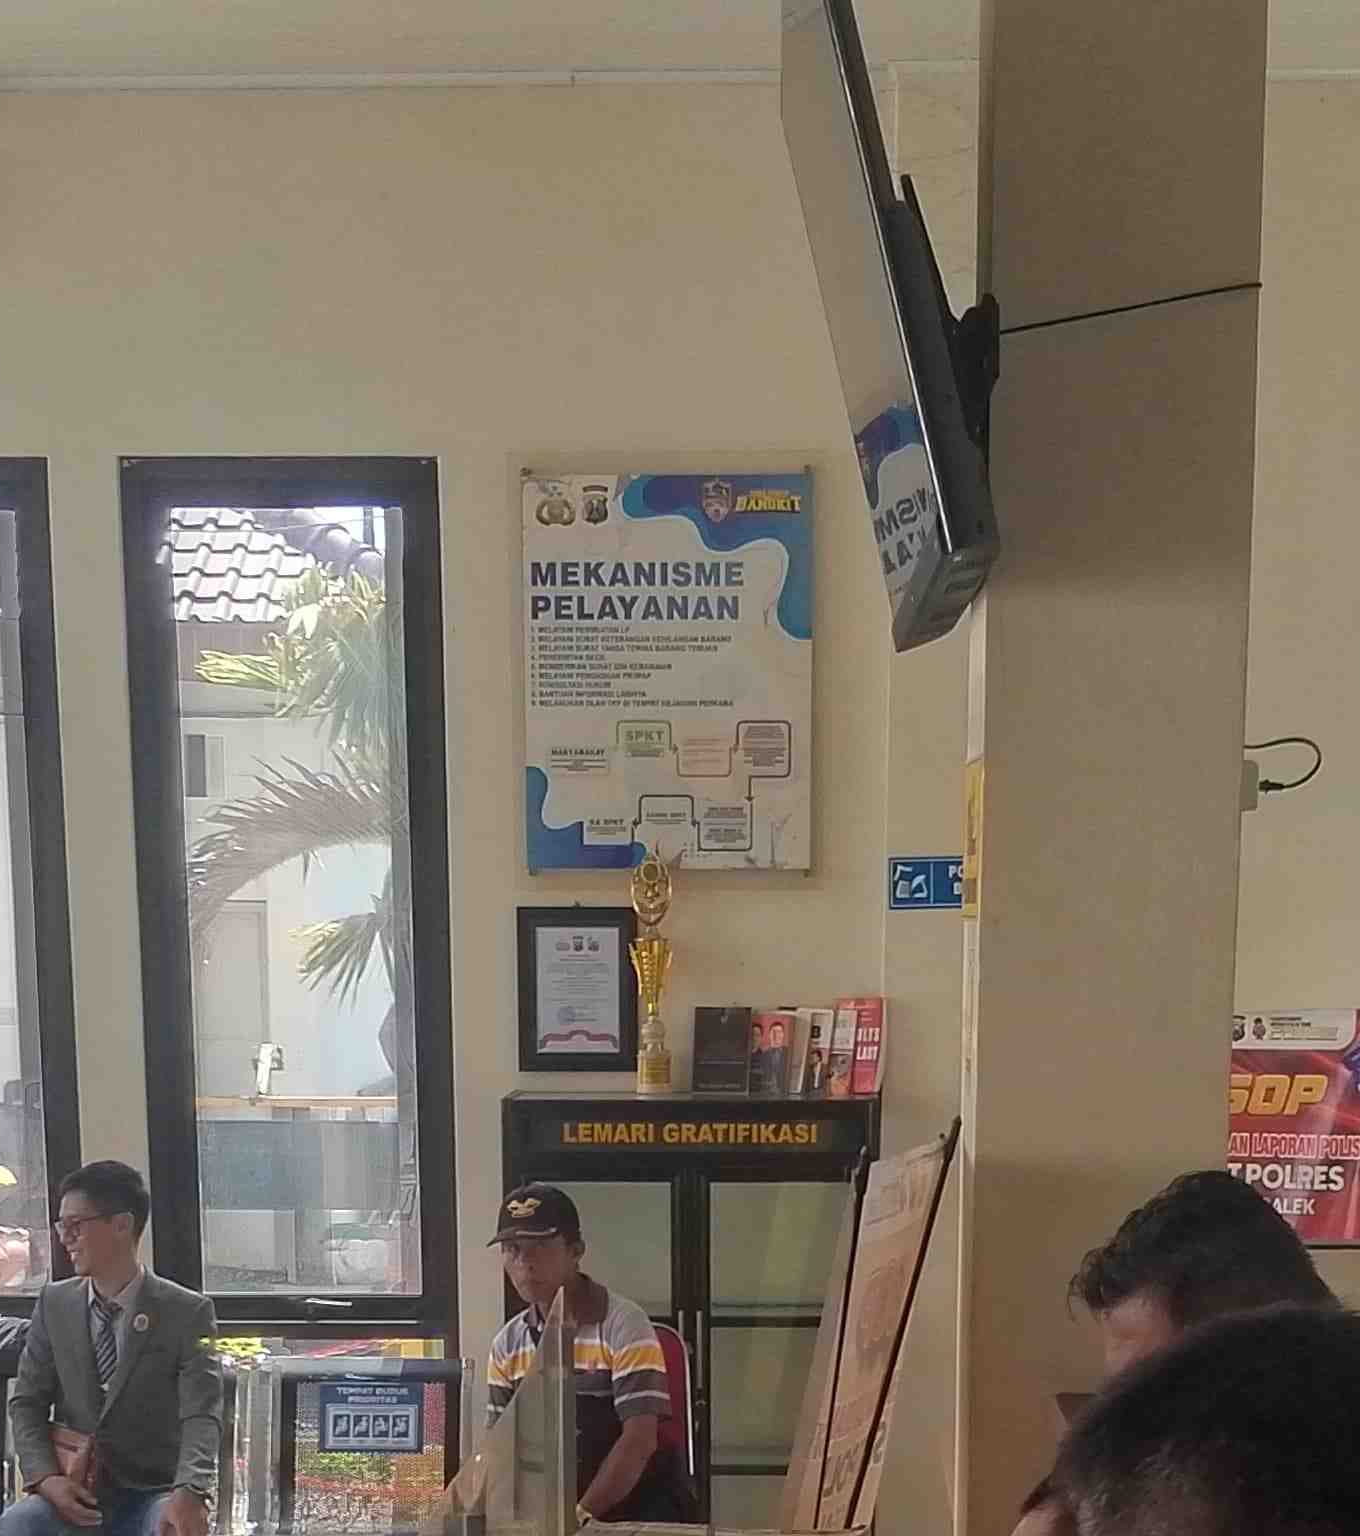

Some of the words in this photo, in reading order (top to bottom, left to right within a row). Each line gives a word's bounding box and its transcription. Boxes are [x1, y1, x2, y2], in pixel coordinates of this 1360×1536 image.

[531, 562, 744, 587] MEKANISME
[531, 595, 738, 620] PELAYANAN
[625, 730, 664, 741] SPKT
[1230, 1073, 1328, 1115] SOP
[563, 1122, 654, 1144] LEMARI
[663, 1122, 817, 1144] GRATIFIKASI
[1252, 1133, 1317, 1158] LAPORAN
[1245, 1163, 1345, 1191] POLRES
[1265, 1197, 1315, 1215] ALEK
